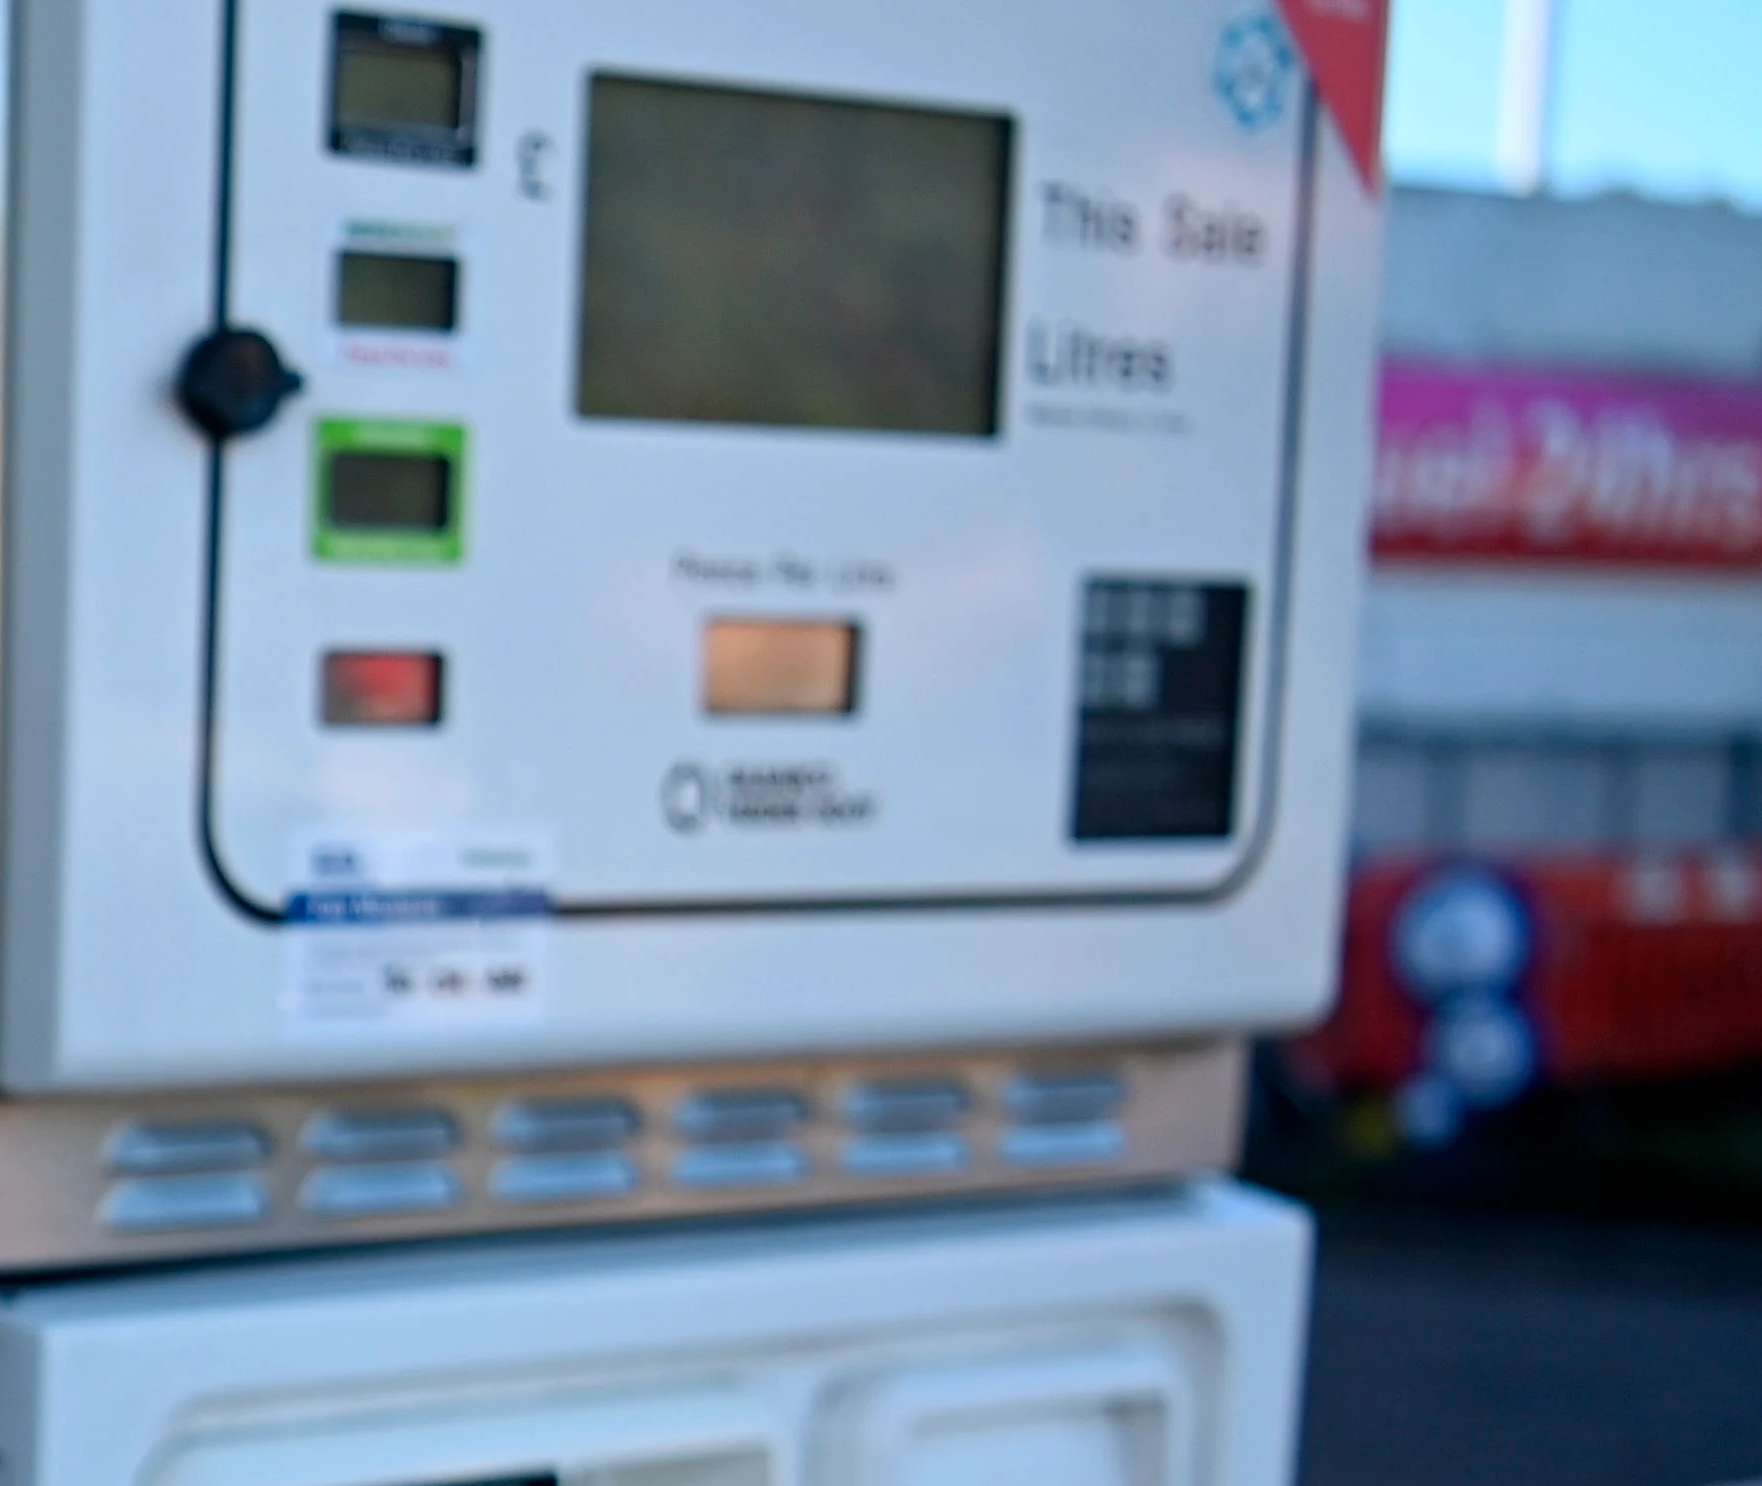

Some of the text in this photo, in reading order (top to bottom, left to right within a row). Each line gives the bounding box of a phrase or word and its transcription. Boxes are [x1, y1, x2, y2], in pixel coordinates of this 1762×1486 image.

[1036, 179, 1267, 269] This Sale
[1026, 314, 1173, 395] Litres
